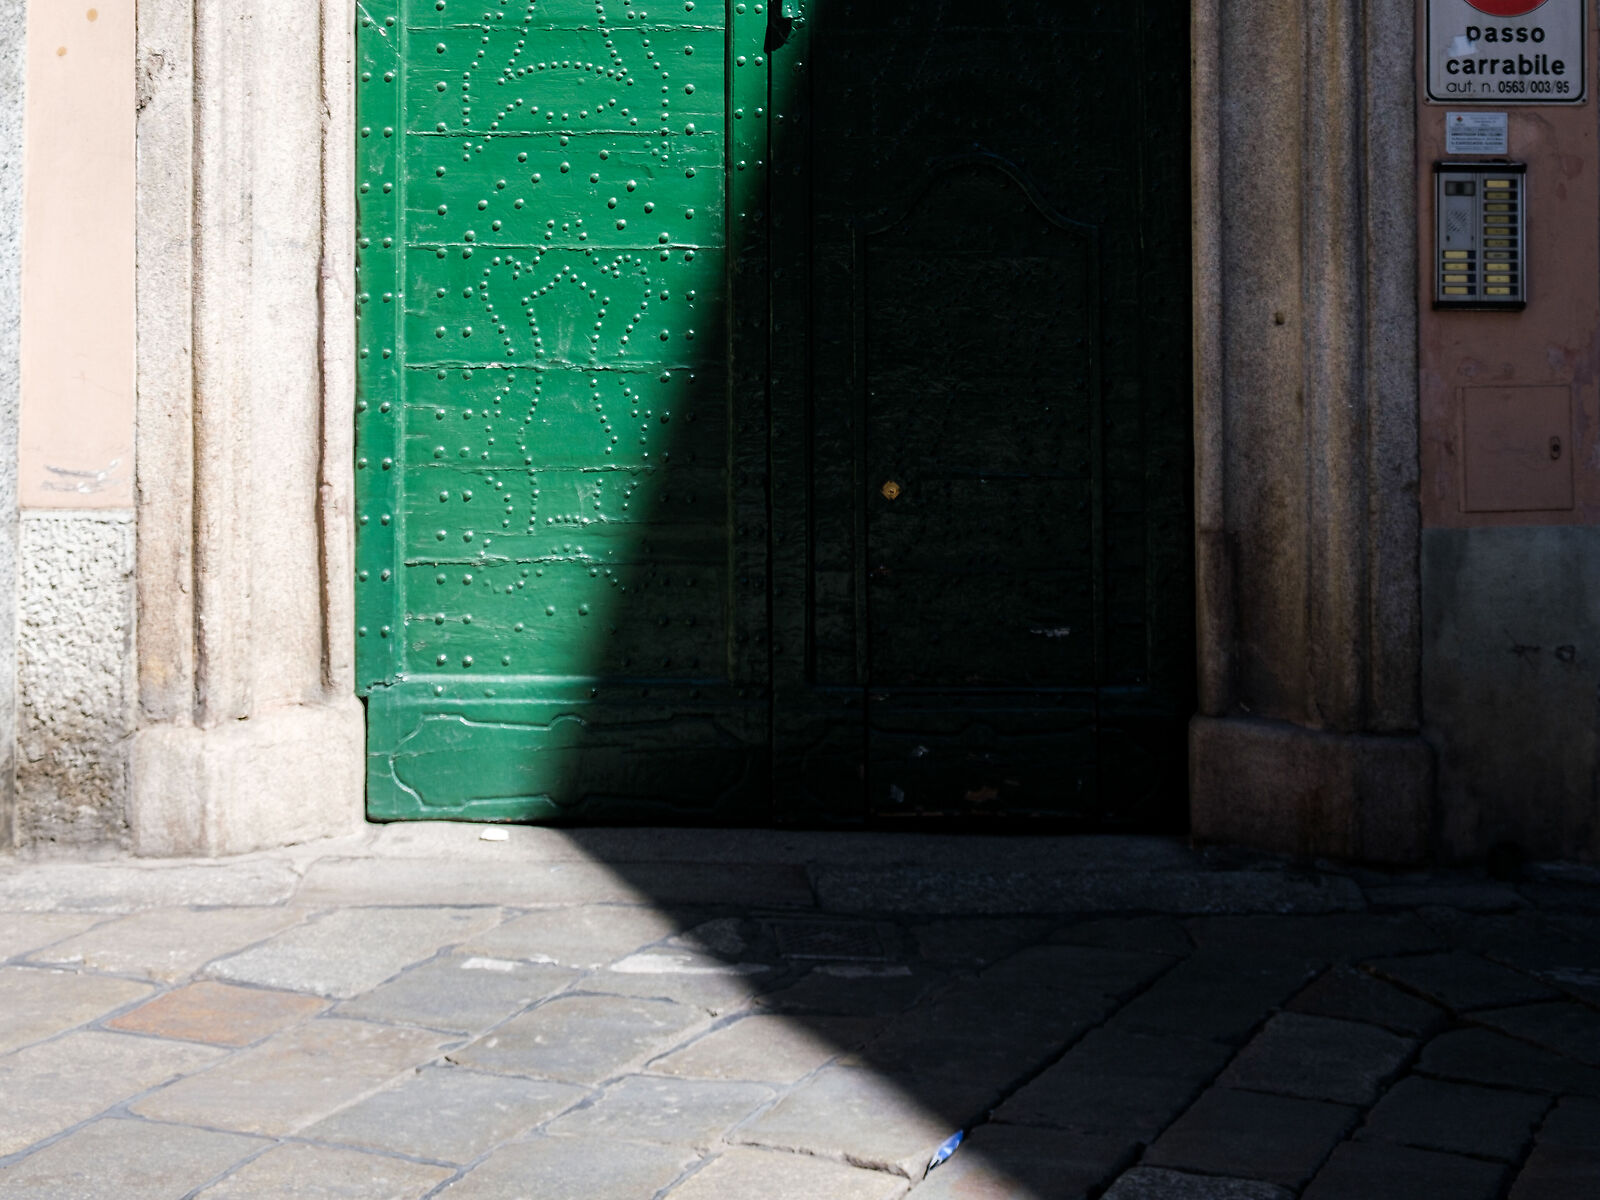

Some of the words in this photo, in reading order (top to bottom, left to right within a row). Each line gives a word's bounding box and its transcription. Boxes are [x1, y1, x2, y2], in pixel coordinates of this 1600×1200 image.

[1466, 26, 1545, 44] passo
[1446, 54, 1565, 75] carrabile
[1446, 80, 1477, 93] aut.
[1482, 82, 1495, 93] n.
[1498, 80, 1570, 94] 0563/003/95
